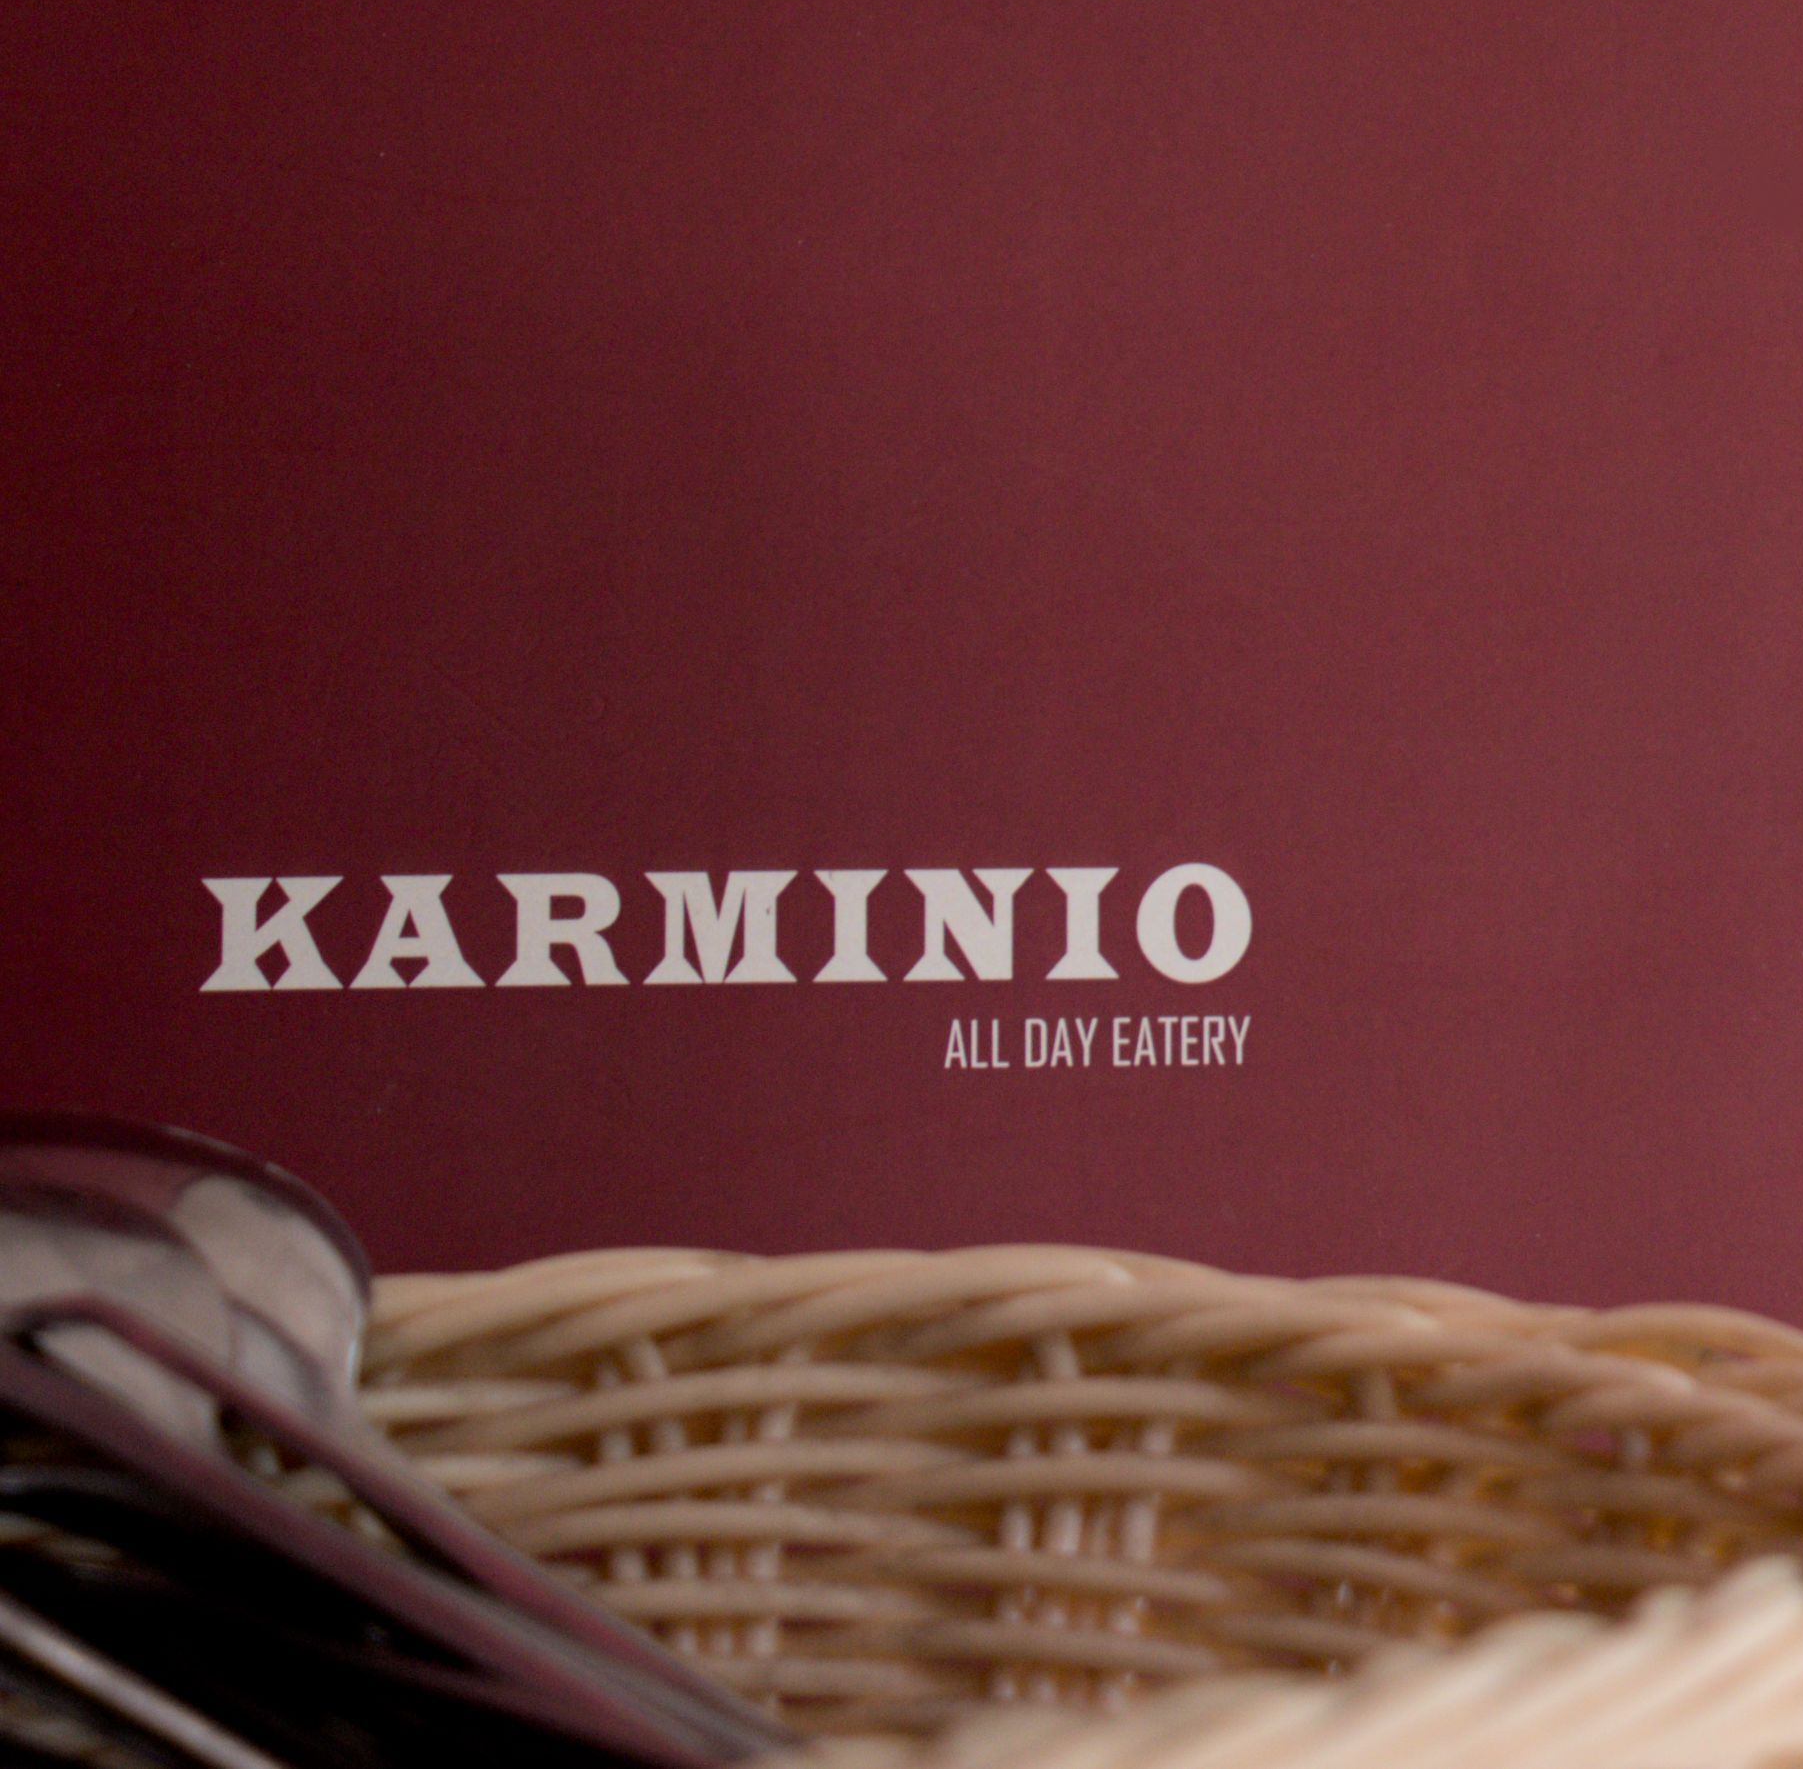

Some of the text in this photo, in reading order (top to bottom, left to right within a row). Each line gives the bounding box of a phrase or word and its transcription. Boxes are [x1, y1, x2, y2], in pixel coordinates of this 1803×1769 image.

[199, 861, 1253, 991] KARMINIO
[943, 1014, 1252, 1069] ALL DAY EATERY
